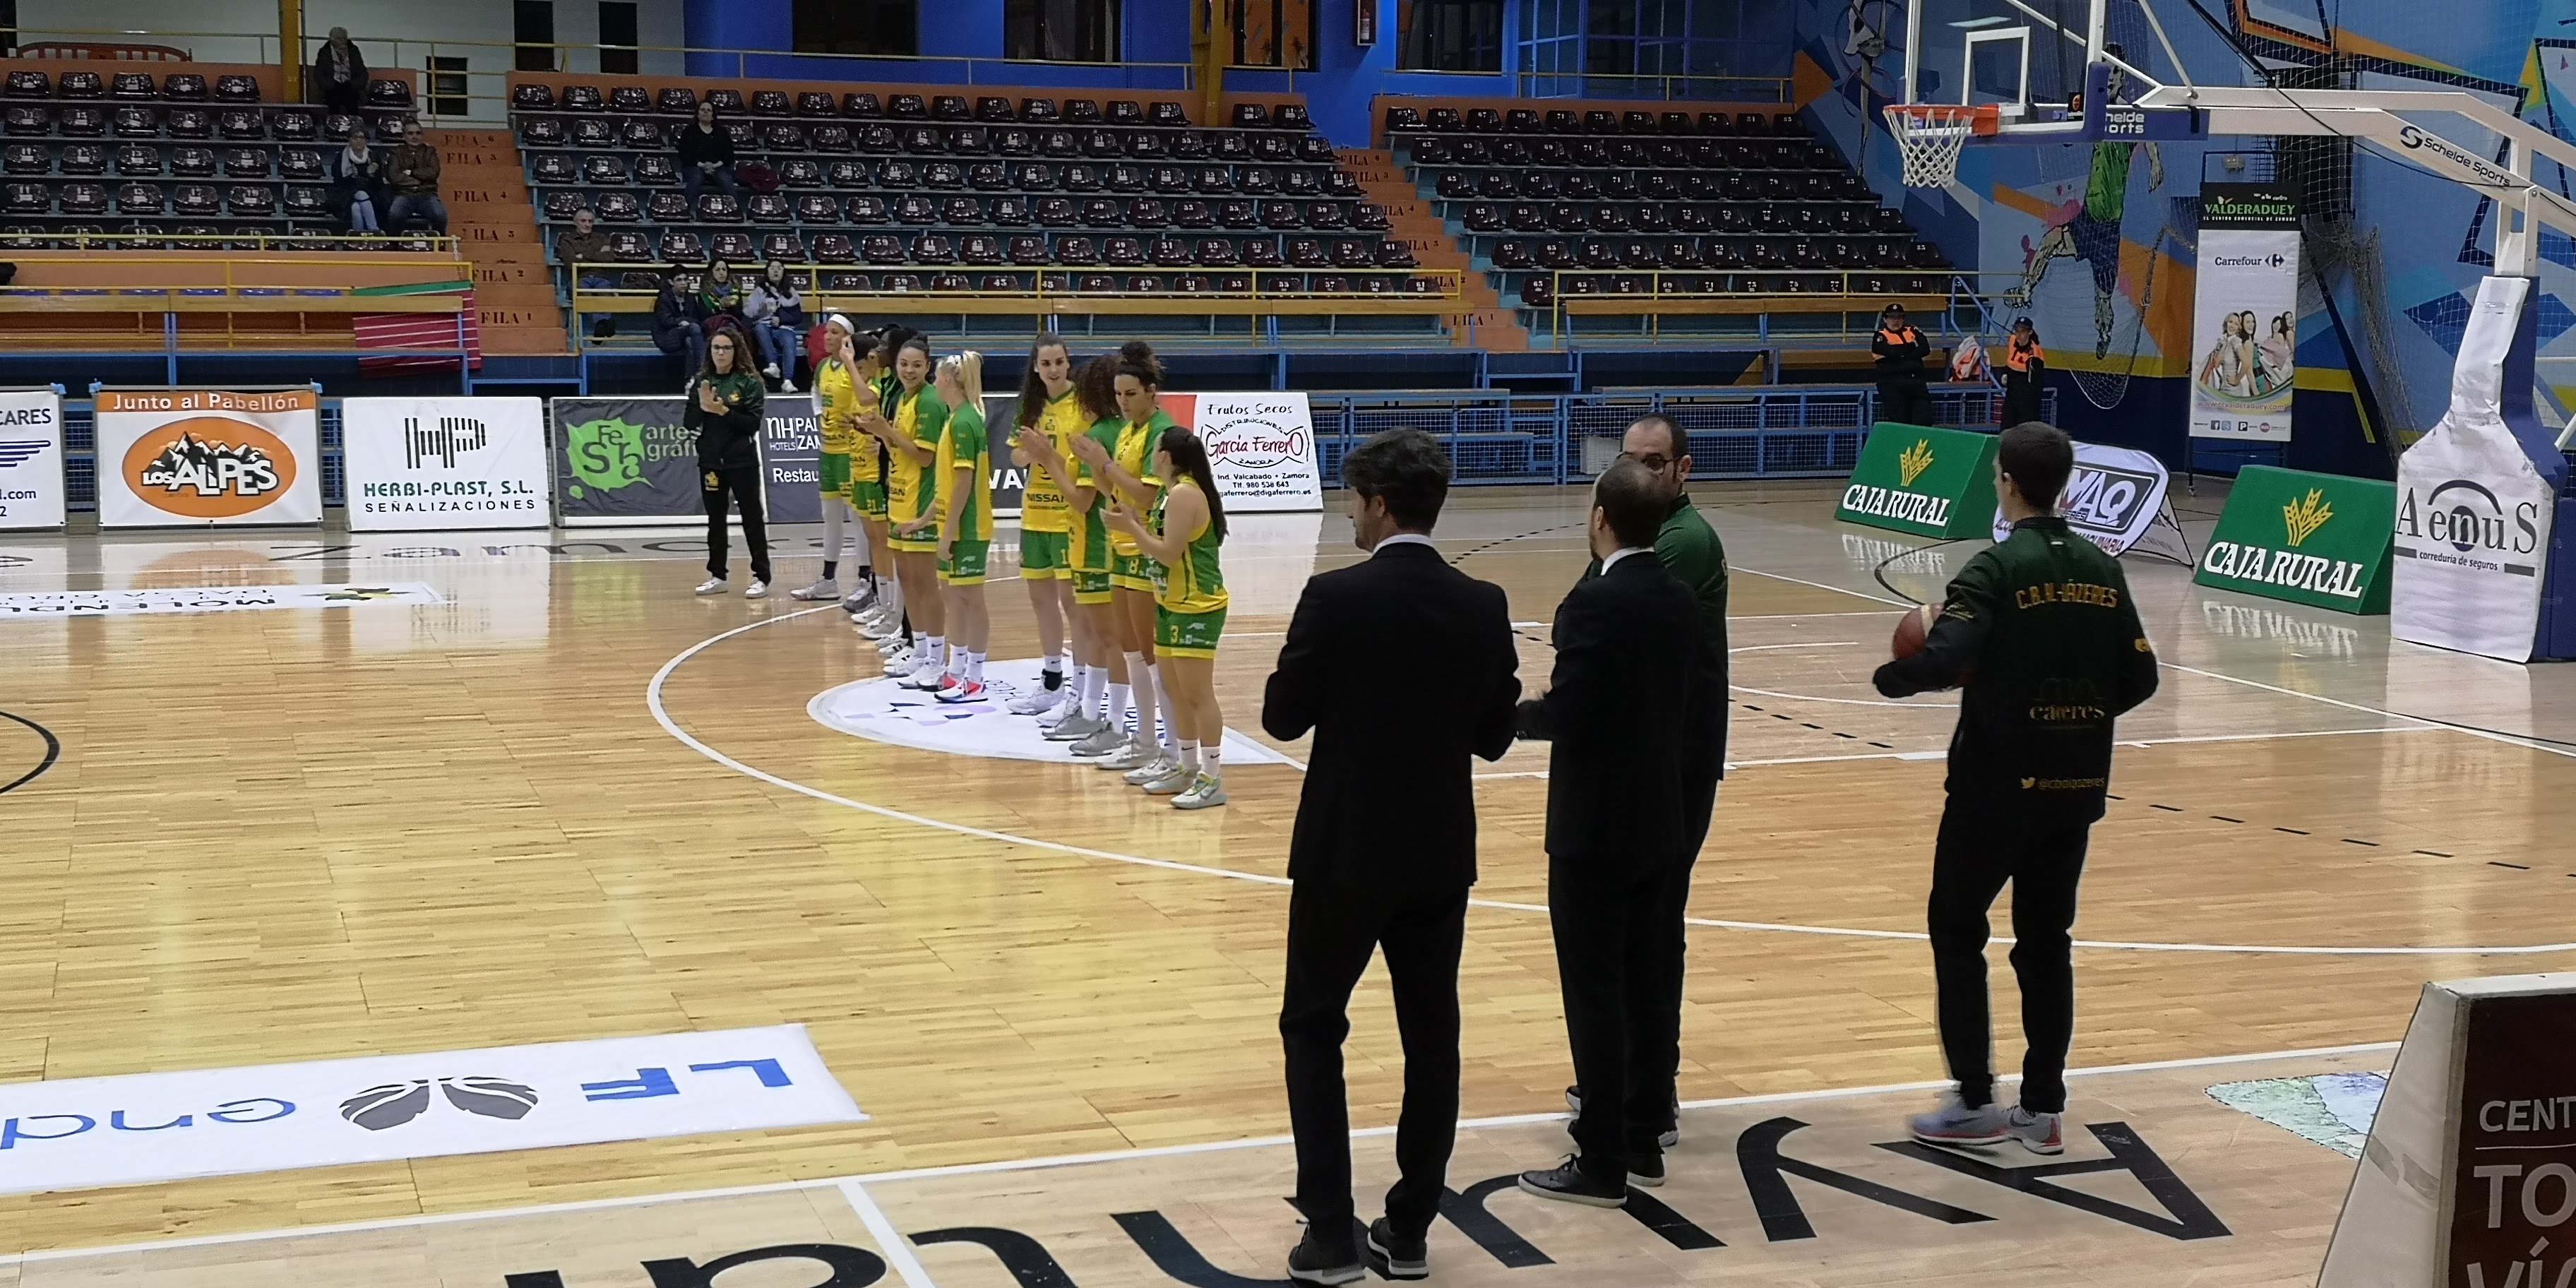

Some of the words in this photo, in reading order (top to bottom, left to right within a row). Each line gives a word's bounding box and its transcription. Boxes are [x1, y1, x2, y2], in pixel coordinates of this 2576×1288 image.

[2104, 124, 2145, 133] orts
[2423, 138, 2471, 167] Schelde
[2472, 162, 2511, 186] Sports
[453, 191, 489, 202] FILA
[1384, 205, 1404, 216] ILA
[2205, 204, 2295, 215] VALDERADUEY
[463, 229, 499, 241] ILA
[1408, 240, 1429, 250] ILA
[2214, 256, 2262, 266] Carrefour
[472, 270, 508, 282] FILA
[481, 312, 519, 323] FILA
[114, 394, 171, 410] Junto
[181, 394, 198, 408] al
[209, 393, 298, 410] Pabellón
[1207, 404, 1248, 415] Frutos
[1254, 403, 1292, 415] Secos
[0, 408, 52, 426] ARES
[645, 424, 701, 440] artes
[769, 442, 796, 451] HOTELS
[143, 471, 177, 485] LOS
[168, 458, 278, 495] ALPES
[364, 481, 492, 497] HERBI-PLAST,
[501, 480, 534, 494] S.L.
[365, 500, 535, 513] SEÑALIZACIONES
[1842, 484, 1887, 515] CAJA
[1882, 490, 1950, 527] RURAL
[2419, 551, 2457, 564] correduría
[2458, 556, 2467, 566] de
[2469, 559, 2498, 571] seguros
[2204, 542, 2267, 580] CAJA
[2264, 550, 2363, 599] RURAL
[1169, 624, 1179, 644] 3
[580, 1058, 793, 1102] LF
[2479, 1096, 2576, 1132] CENT
